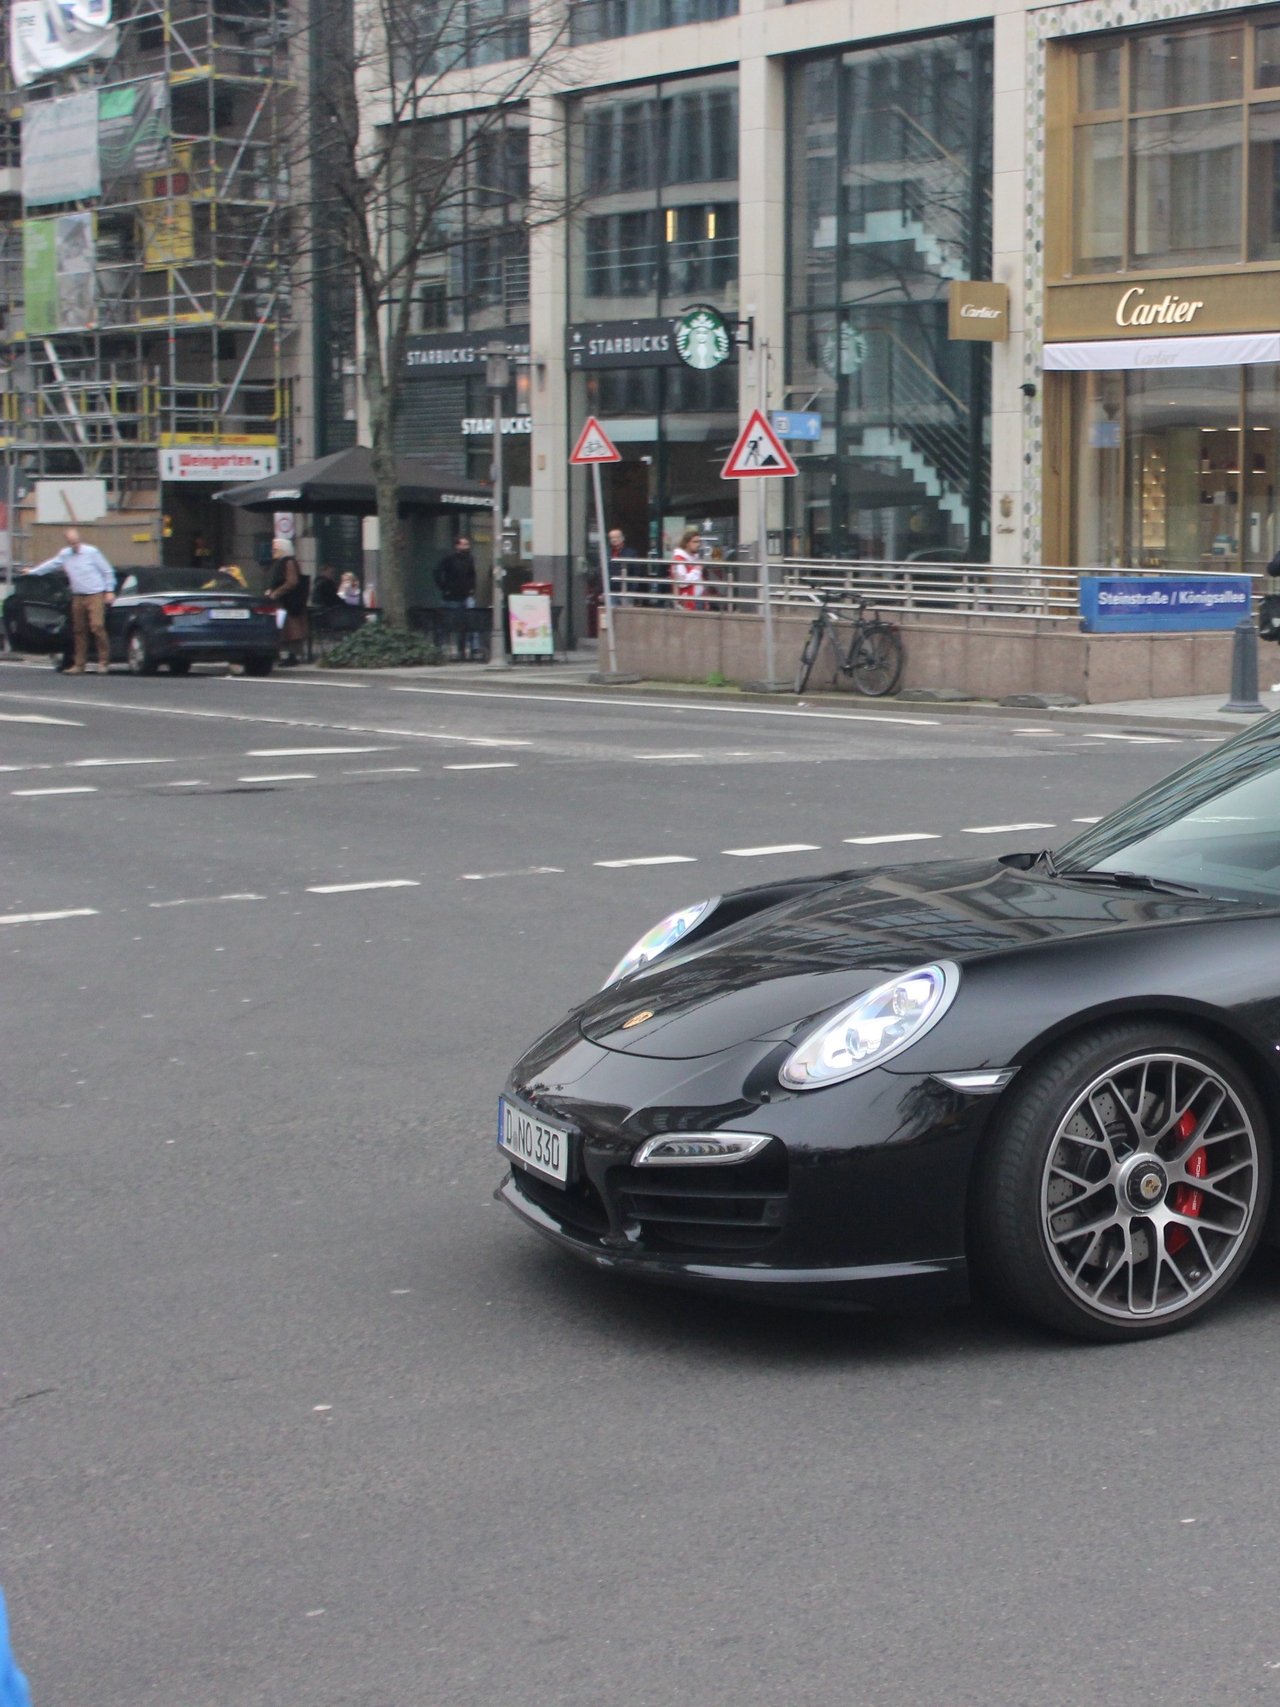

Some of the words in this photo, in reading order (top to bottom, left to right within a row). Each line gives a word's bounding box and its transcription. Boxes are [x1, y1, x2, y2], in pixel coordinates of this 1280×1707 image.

[960, 304, 1001, 319] Cartier
[1115, 287, 1203, 327] Cartier
[588, 335, 669, 355] STARBUCKS
[407, 348, 475, 365] STARBUCKS
[461, 417, 532, 435] STARUCKS
[1098, 591, 1169, 606] Steinstraße
[1179, 590, 1246, 607] Königsallee
[535, 1126, 560, 1170] 330
